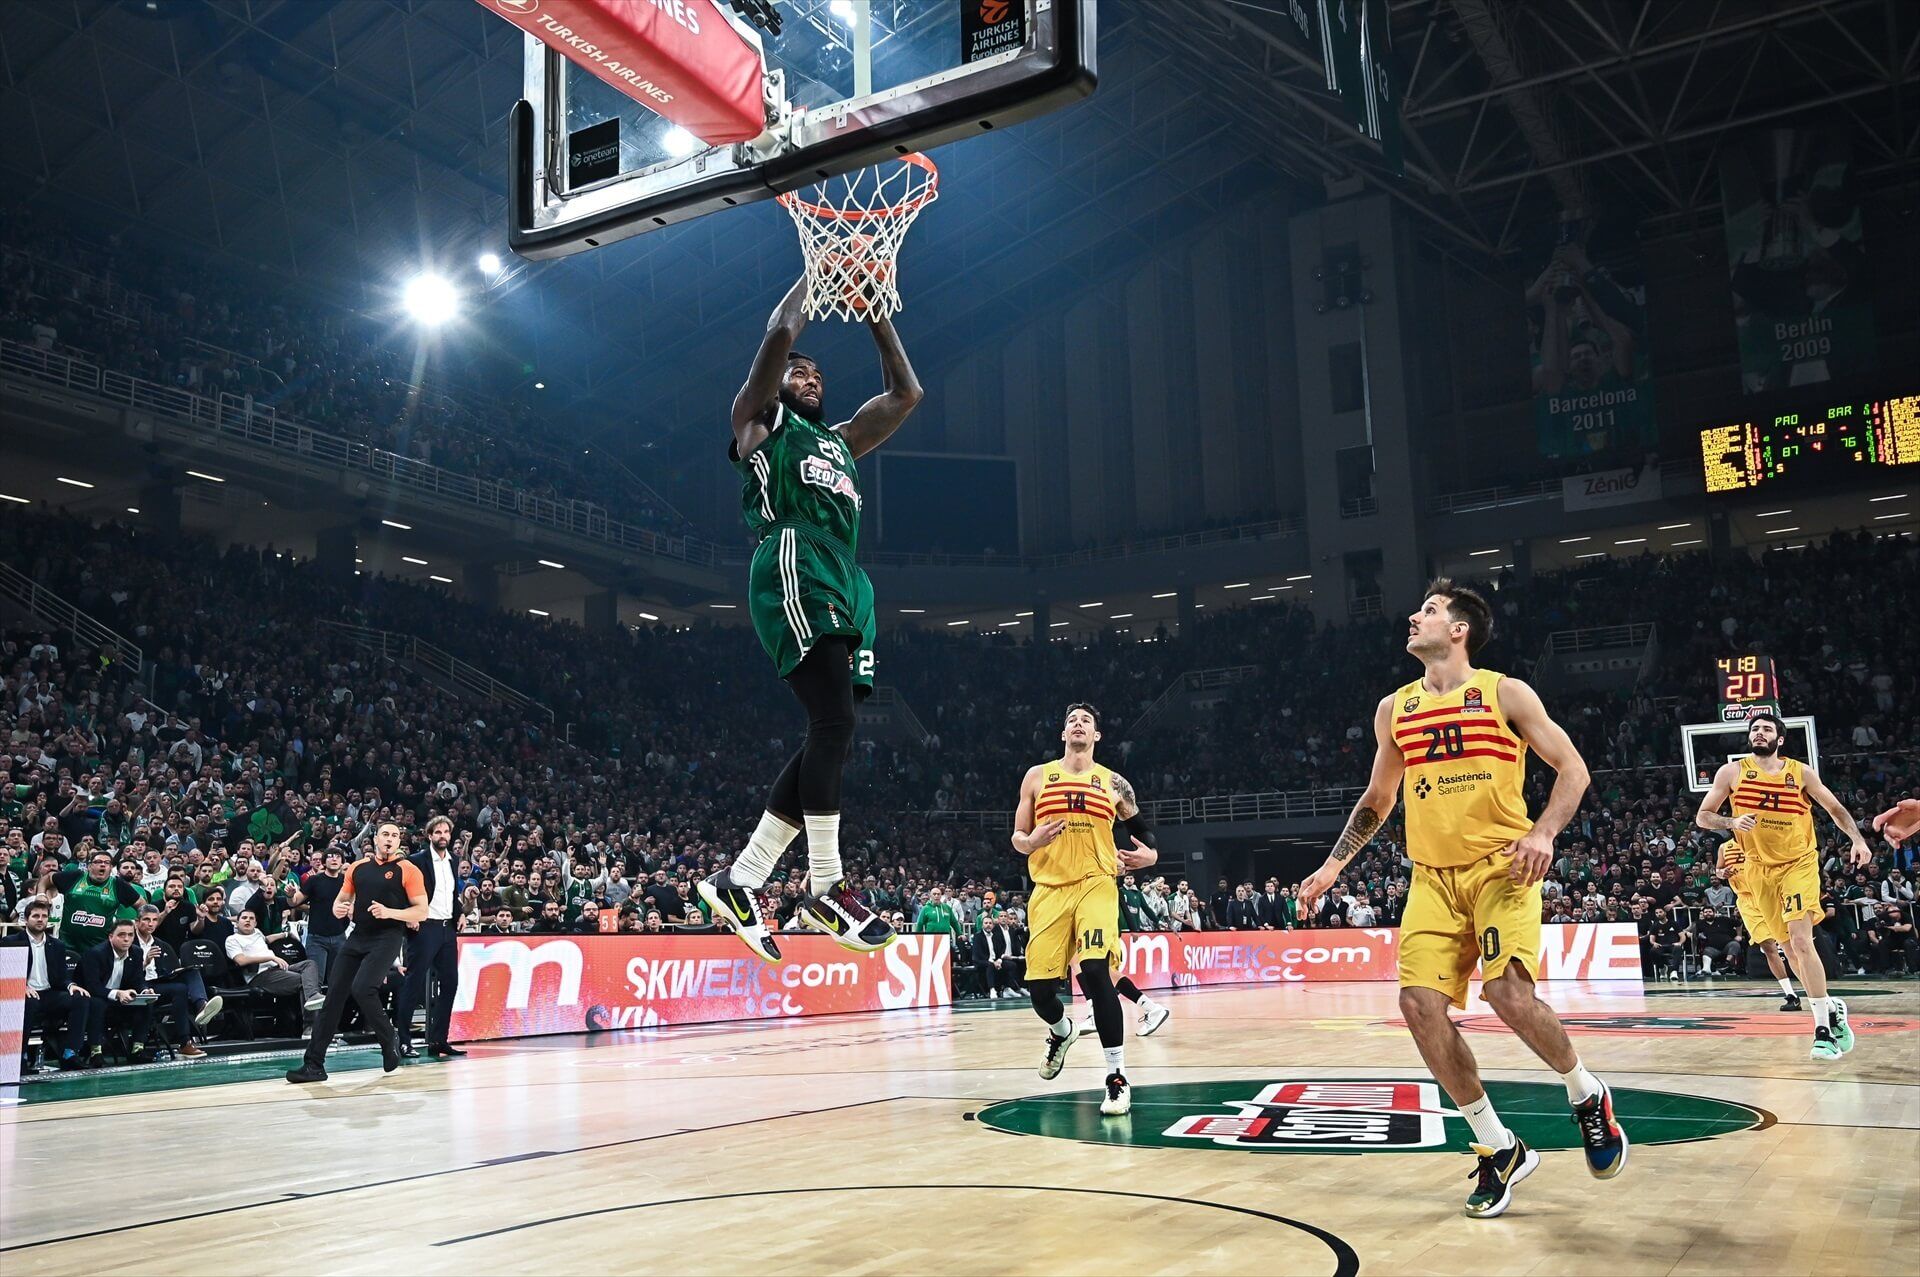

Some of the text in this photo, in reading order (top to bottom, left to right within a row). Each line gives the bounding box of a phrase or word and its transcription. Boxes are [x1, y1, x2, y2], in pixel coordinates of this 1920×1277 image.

[972, 18, 1019, 42] TURKISH
[972, 29, 1020, 53] AIRLINES
[536, 14, 674, 104] TURKISH AIRLINES
[583, 146, 618, 164] oneteam
[1775, 317, 1832, 341] Berlin
[1781, 337, 1832, 362] 2009
[1548, 388, 1638, 414] Barcelona
[1828, 405, 1852, 419] BAR
[1572, 410, 1615, 432] 2011
[1775, 414, 1798, 427] PAO
[816, 436, 845, 466] 26
[1782, 446, 1799, 458] 87
[1841, 436, 1857, 448] 76
[1726, 673, 1765, 699] 20
[1423, 723, 1465, 761] 20
[1437, 771, 1492, 785] Assistència
[1065, 791, 1086, 812] 14
[1758, 791, 1779, 810] 21
[1784, 893, 1802, 914] 21
[1083, 928, 1104, 950] 14
